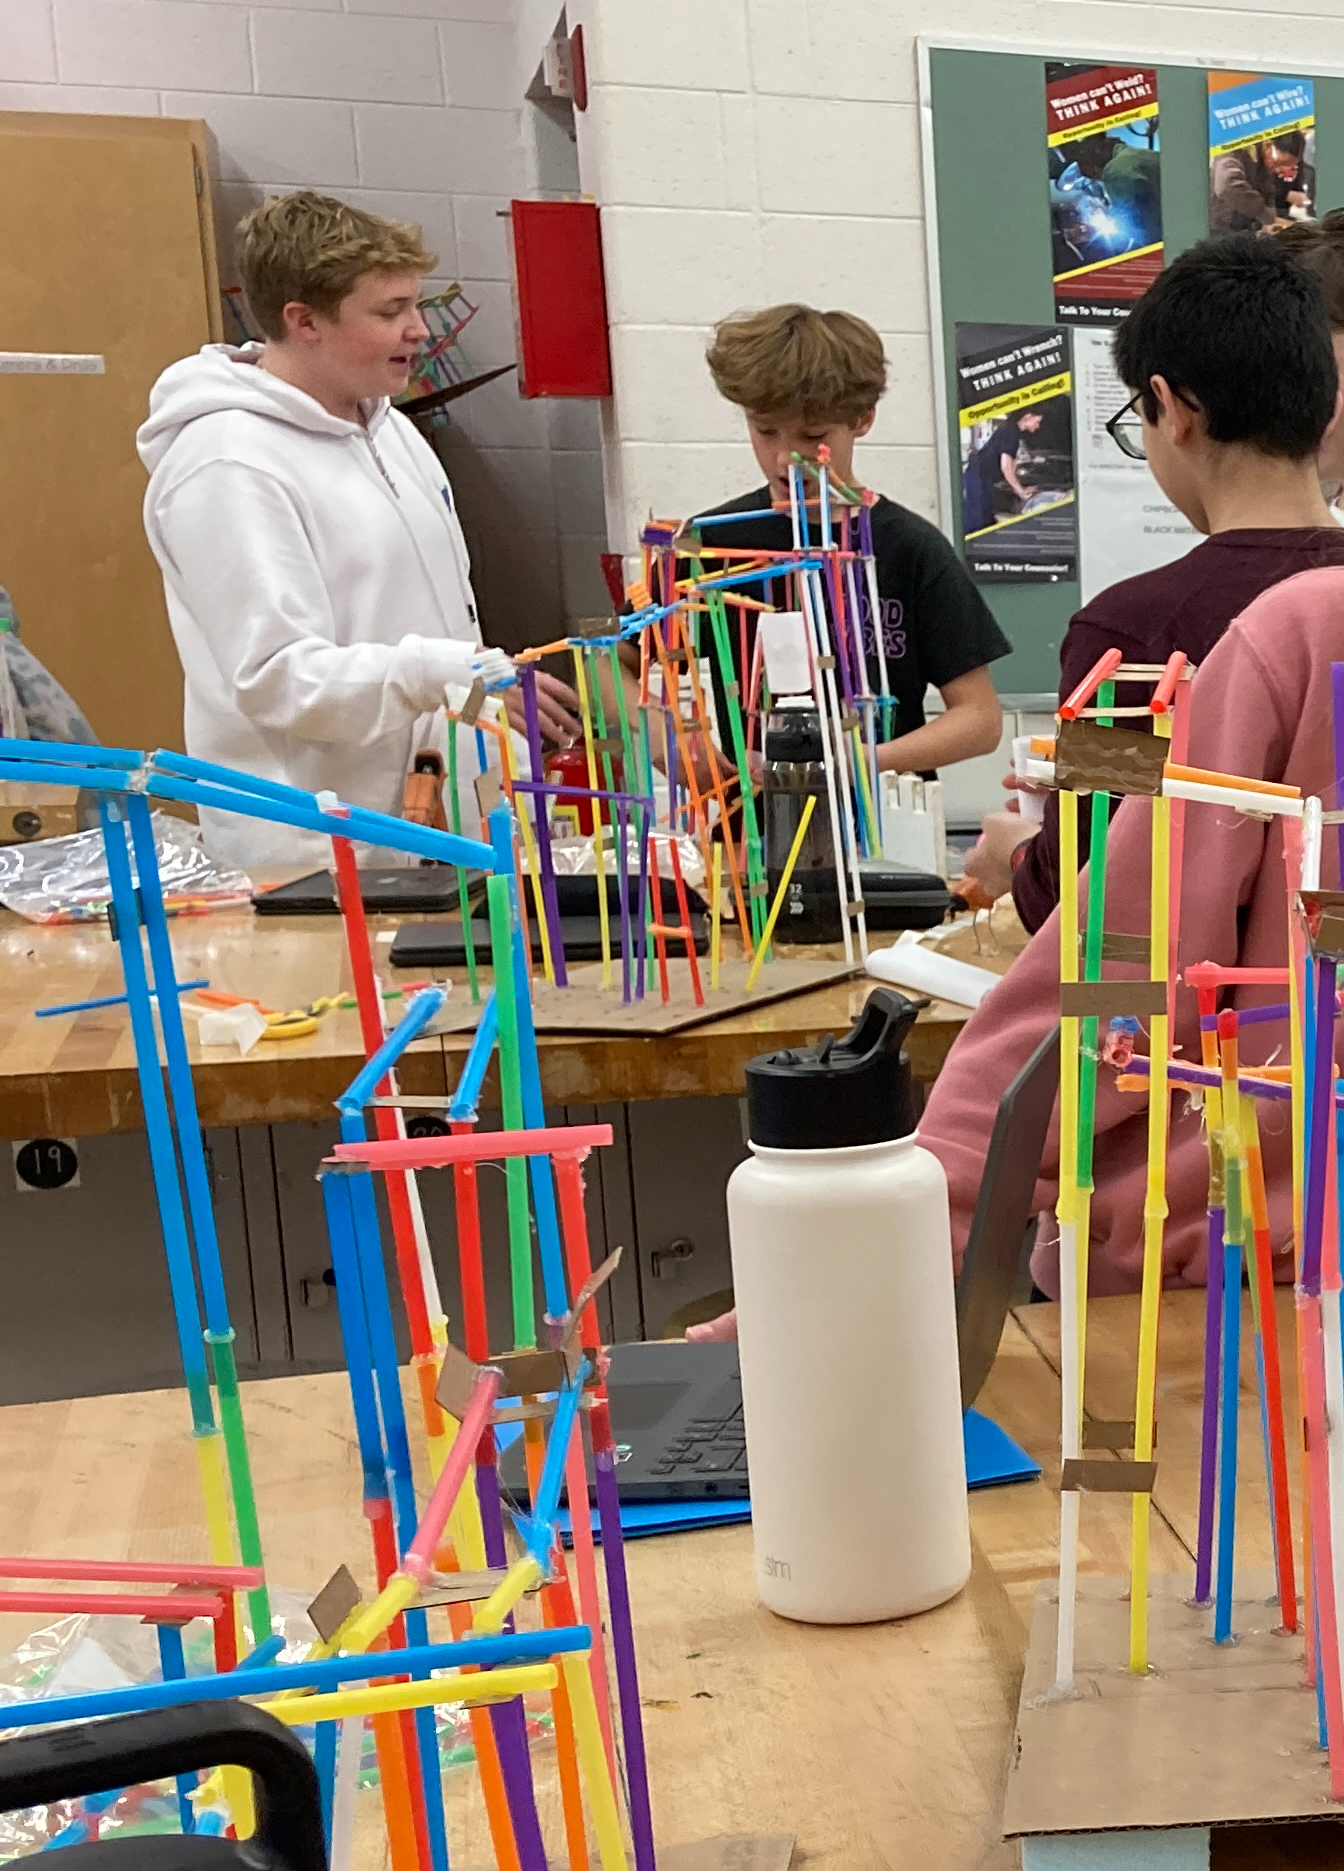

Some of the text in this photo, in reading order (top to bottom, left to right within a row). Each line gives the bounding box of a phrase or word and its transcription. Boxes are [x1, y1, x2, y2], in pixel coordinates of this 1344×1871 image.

[1050, 73, 1144, 109] Women can't Weld?
[1056, 83, 1152, 121] THINK AGAIN!
[1213, 103, 1250, 119] Women
[1219, 94, 1310, 130] THINK AGAIN!
[1058, 305, 1078, 315] Talk
[1079, 305, 1090, 316] To
[1091, 306, 1112, 316] Your
[960, 334, 1062, 379] Women can't Wrench?
[972, 351, 1061, 391] THINK AGAIN!
[974, 562, 992, 572] Talk
[993, 563, 1003, 572] To
[1004, 563, 1023, 572] Your
[34, 1145, 62, 1175] 19
